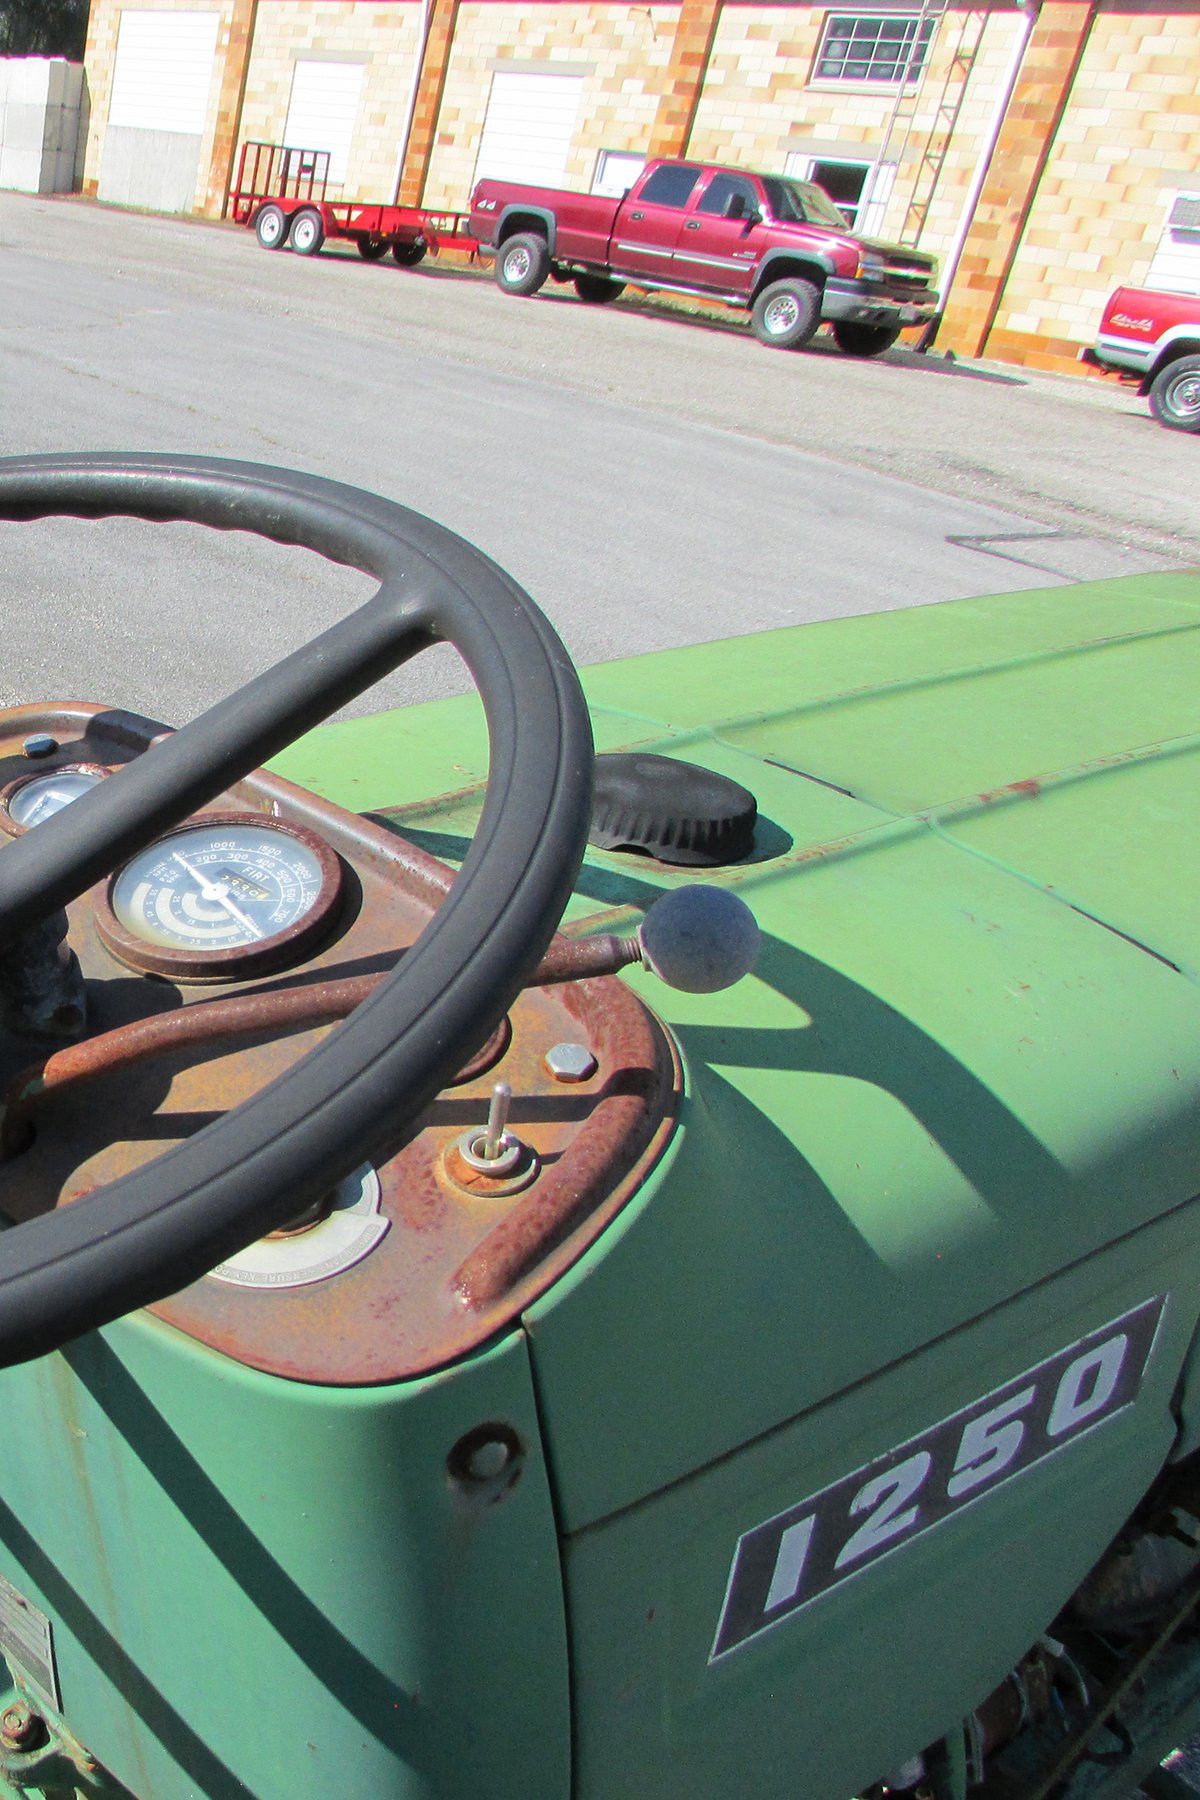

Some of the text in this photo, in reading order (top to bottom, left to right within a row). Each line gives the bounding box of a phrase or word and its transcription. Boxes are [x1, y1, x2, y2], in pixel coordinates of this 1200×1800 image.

[210, 841, 236, 849] 1000
[258, 844, 282, 856] 1500
[196, 854, 218, 863] 200
[227, 852, 249, 860] 300
[255, 858, 276, 869] 400
[292, 861, 312, 879] 2000
[242, 866, 270, 883] FIAT
[277, 869, 293, 884] 500
[286, 888, 296, 903] 600
[271, 910, 290, 924] 700
[234, 1270, 256, 1281] KEY
[262, 1270, 308, 1283] ENSURE
[763, 1333, 1129, 1614] 1250
